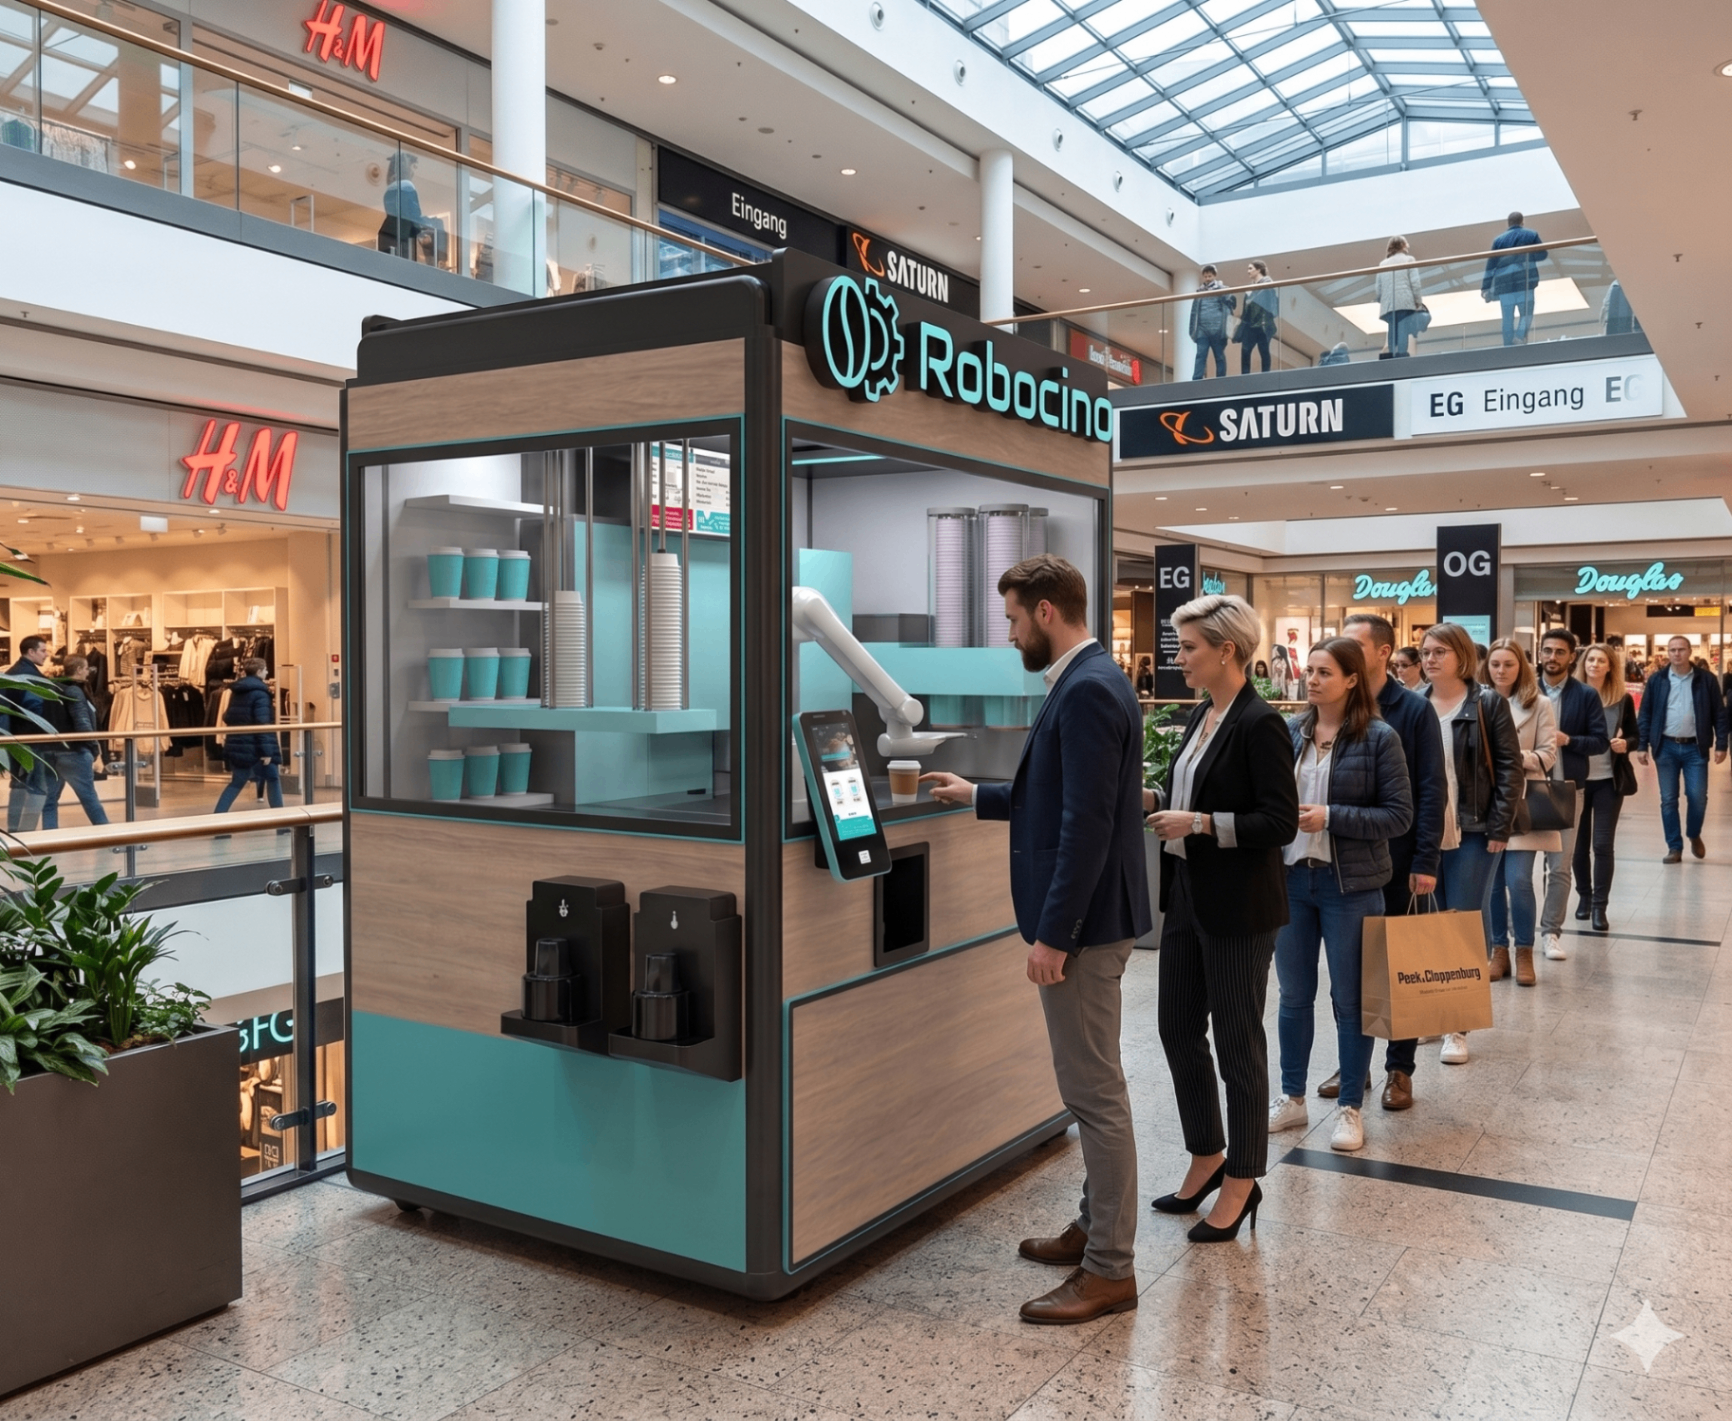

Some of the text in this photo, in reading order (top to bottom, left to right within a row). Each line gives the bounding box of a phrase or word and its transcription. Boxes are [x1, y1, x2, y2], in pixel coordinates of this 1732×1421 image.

[304, 0, 385, 82] H&M
[731, 192, 788, 240] Eingang
[887, 250, 949, 304] SATURN
[919, 320, 1113, 443] Robocino
[1430, 391, 1464, 418] EG
[1484, 386, 1584, 414] Eingang
[1219, 398, 1343, 442] SATURN
[181, 418, 298, 512] H&M
[1160, 566, 1190, 588] EG
[1443, 550, 1491, 577] OG
[1575, 562, 1684, 599] Douglas
[1353, 568, 1437, 605] Dougla
